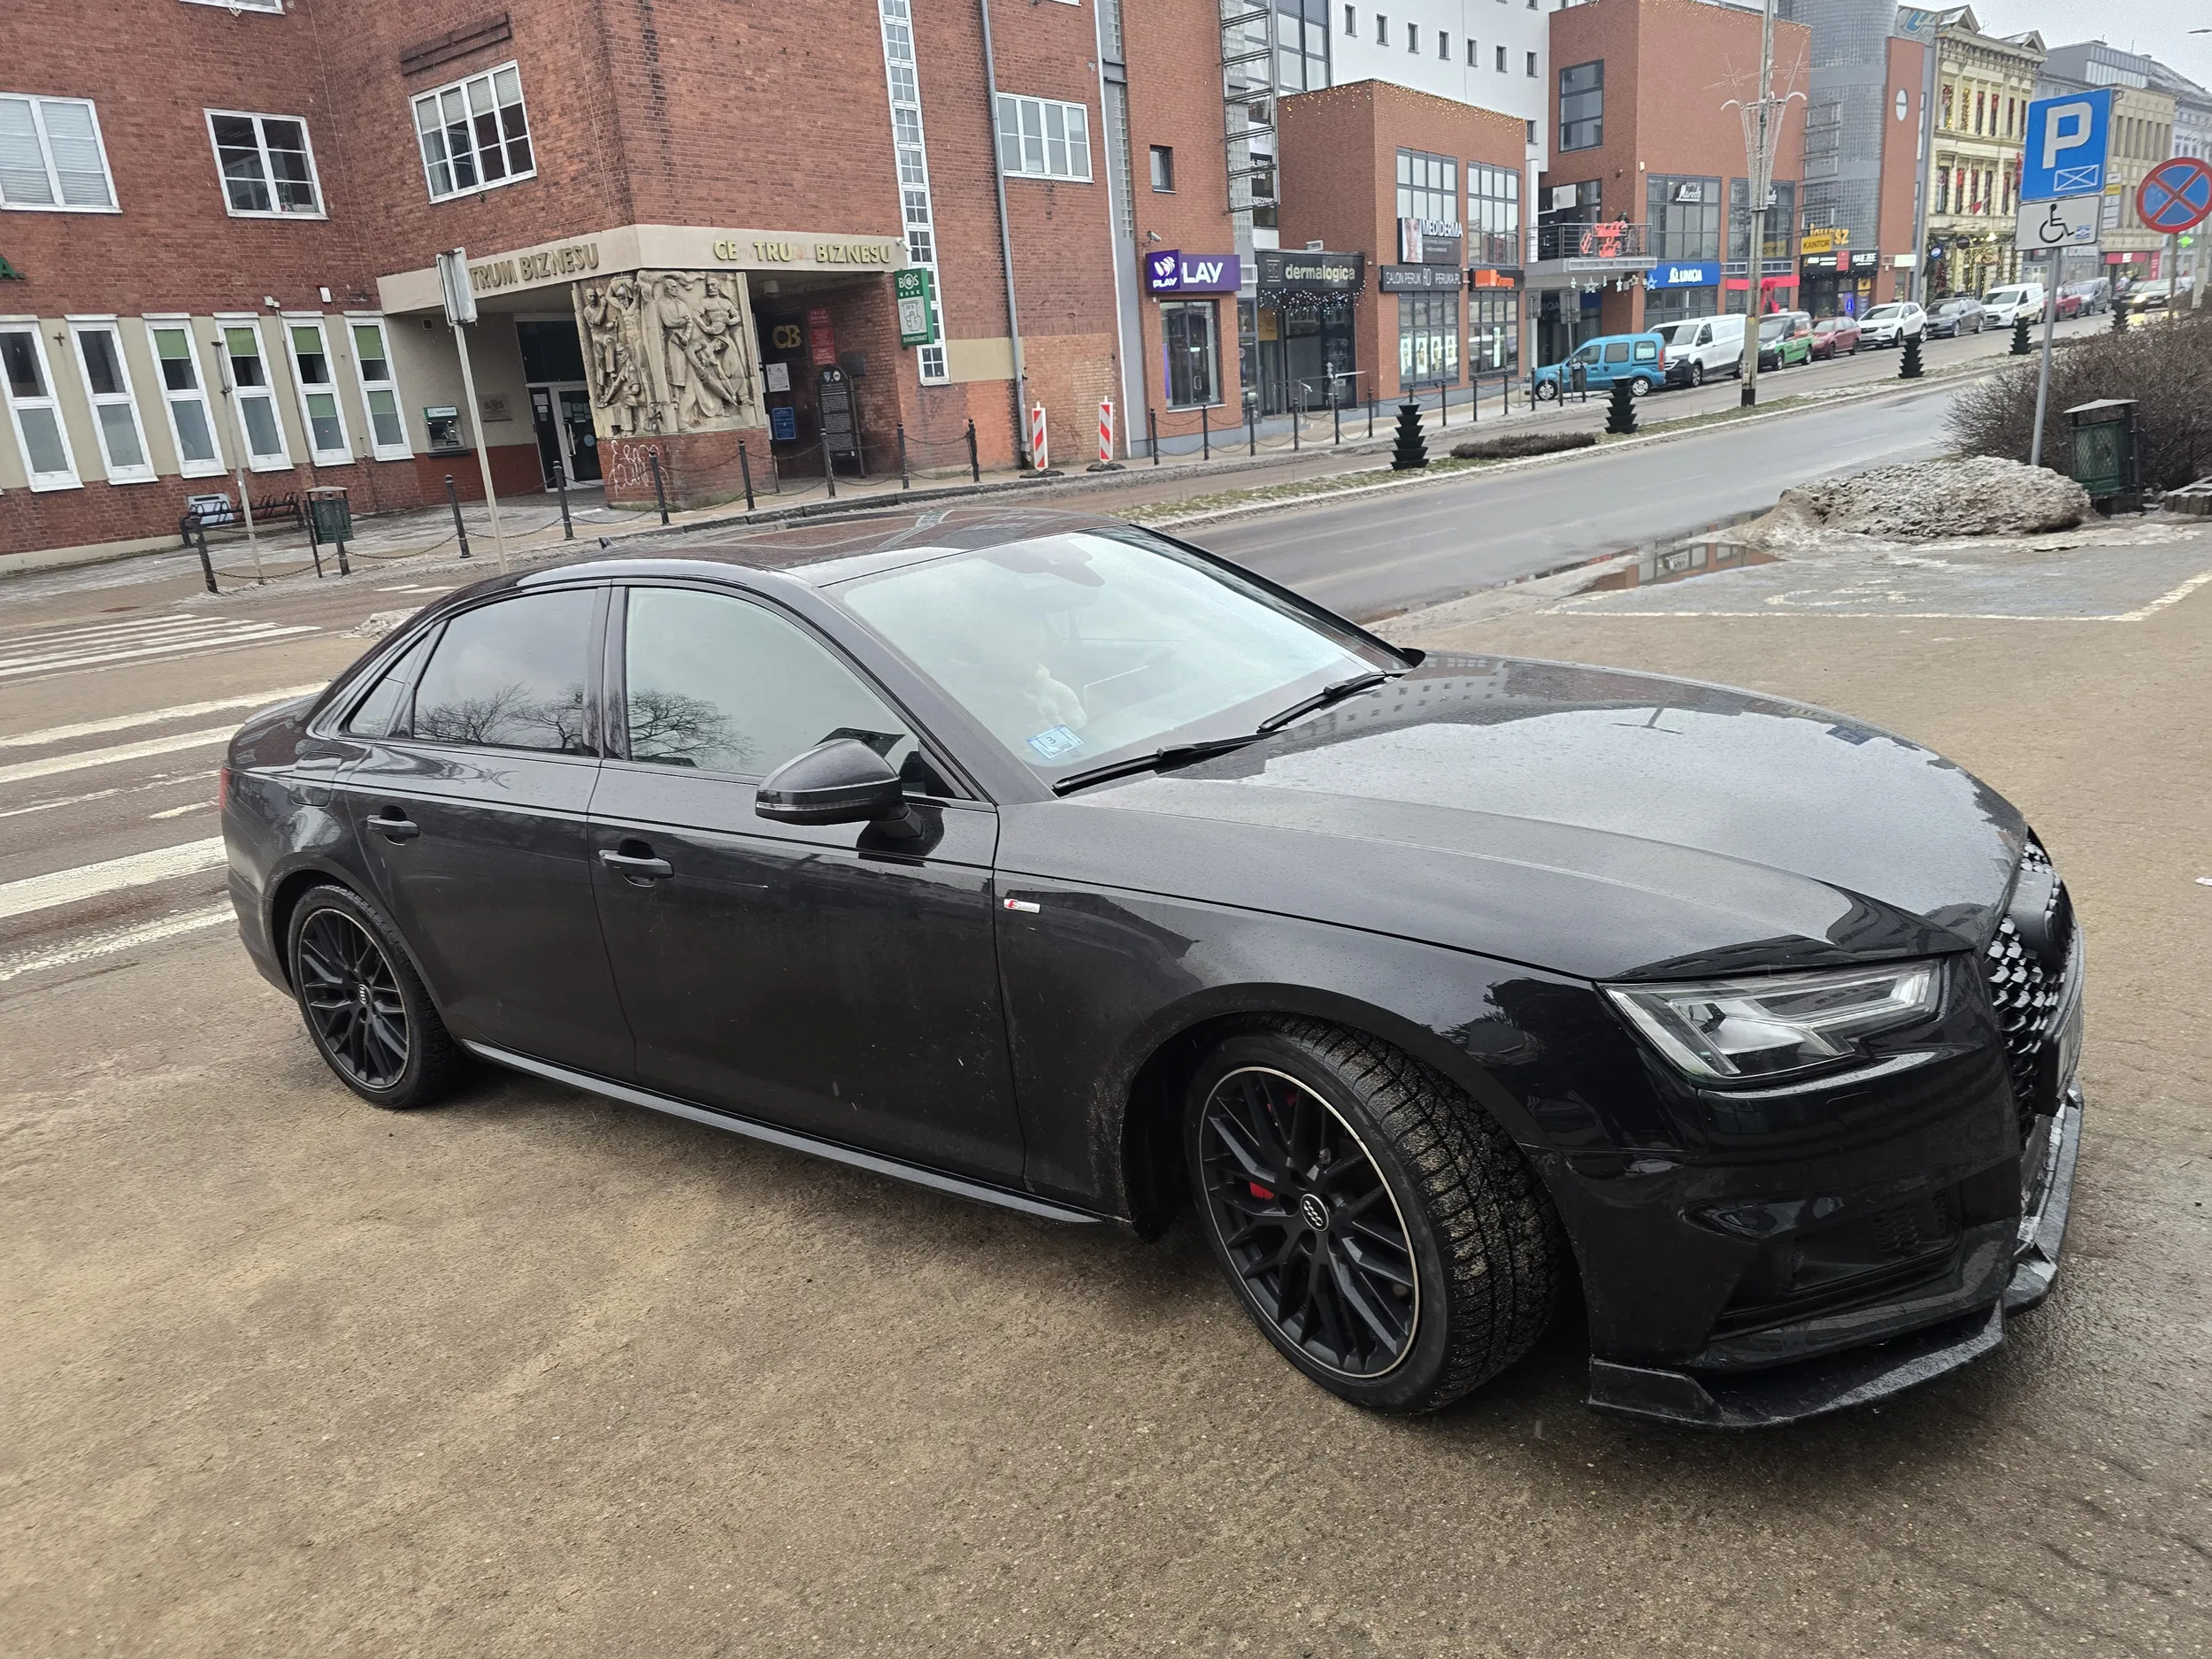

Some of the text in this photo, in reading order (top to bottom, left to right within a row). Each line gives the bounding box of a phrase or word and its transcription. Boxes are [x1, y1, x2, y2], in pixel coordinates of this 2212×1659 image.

[2042, 102, 2093, 169] P
[815, 243, 892, 263] BIZNESU
[1802, 240, 1830, 250] KANTOR
[469, 243, 600, 290] TRUM BIZNESU
[1182, 262, 1224, 283] LAY
[1285, 264, 1356, 282] dermalogica
[1153, 278, 1178, 288] PLAY
[1386, 272, 1404, 284] SALON
[772, 324, 802, 349] CB
